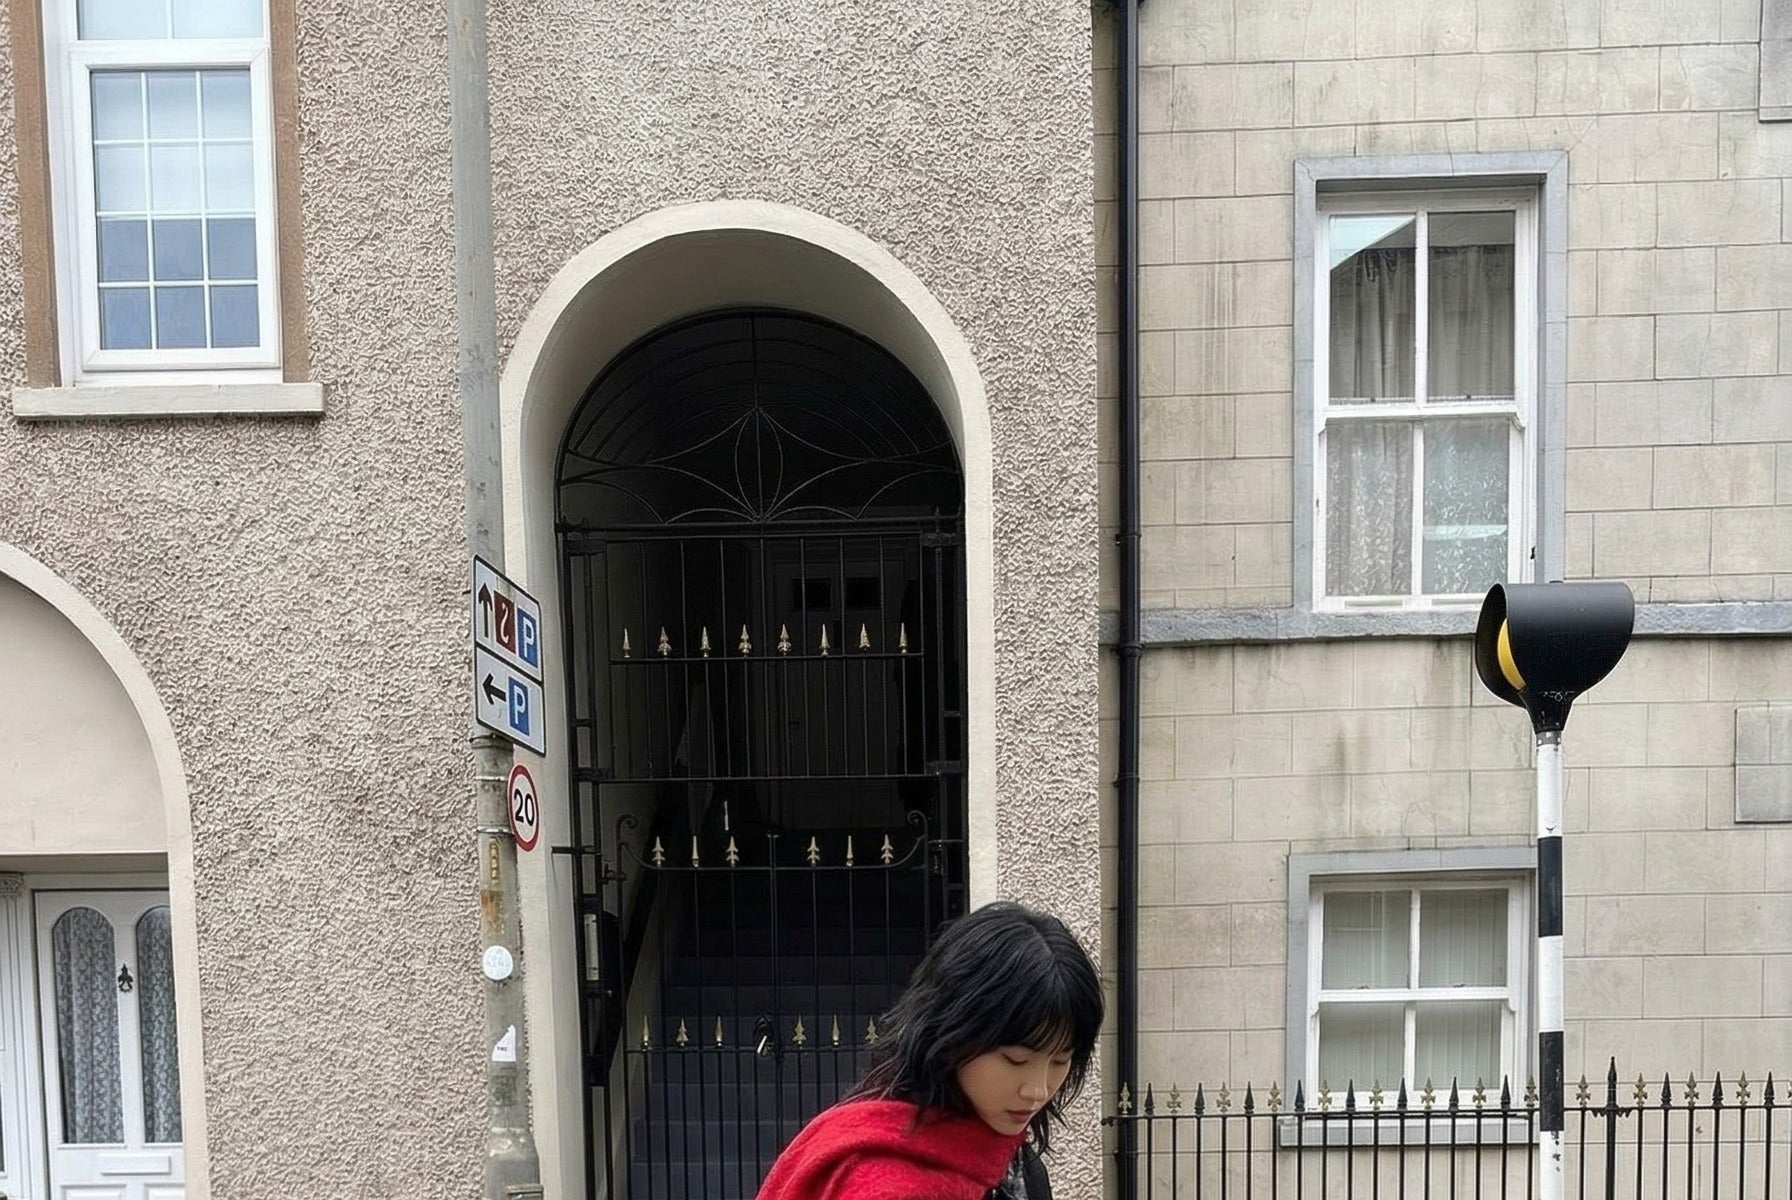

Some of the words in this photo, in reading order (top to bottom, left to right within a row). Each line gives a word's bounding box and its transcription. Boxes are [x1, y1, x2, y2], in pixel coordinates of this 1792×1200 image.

[522, 616, 535, 658] P
[513, 684, 526, 725] P
[514, 788, 535, 827] 20
